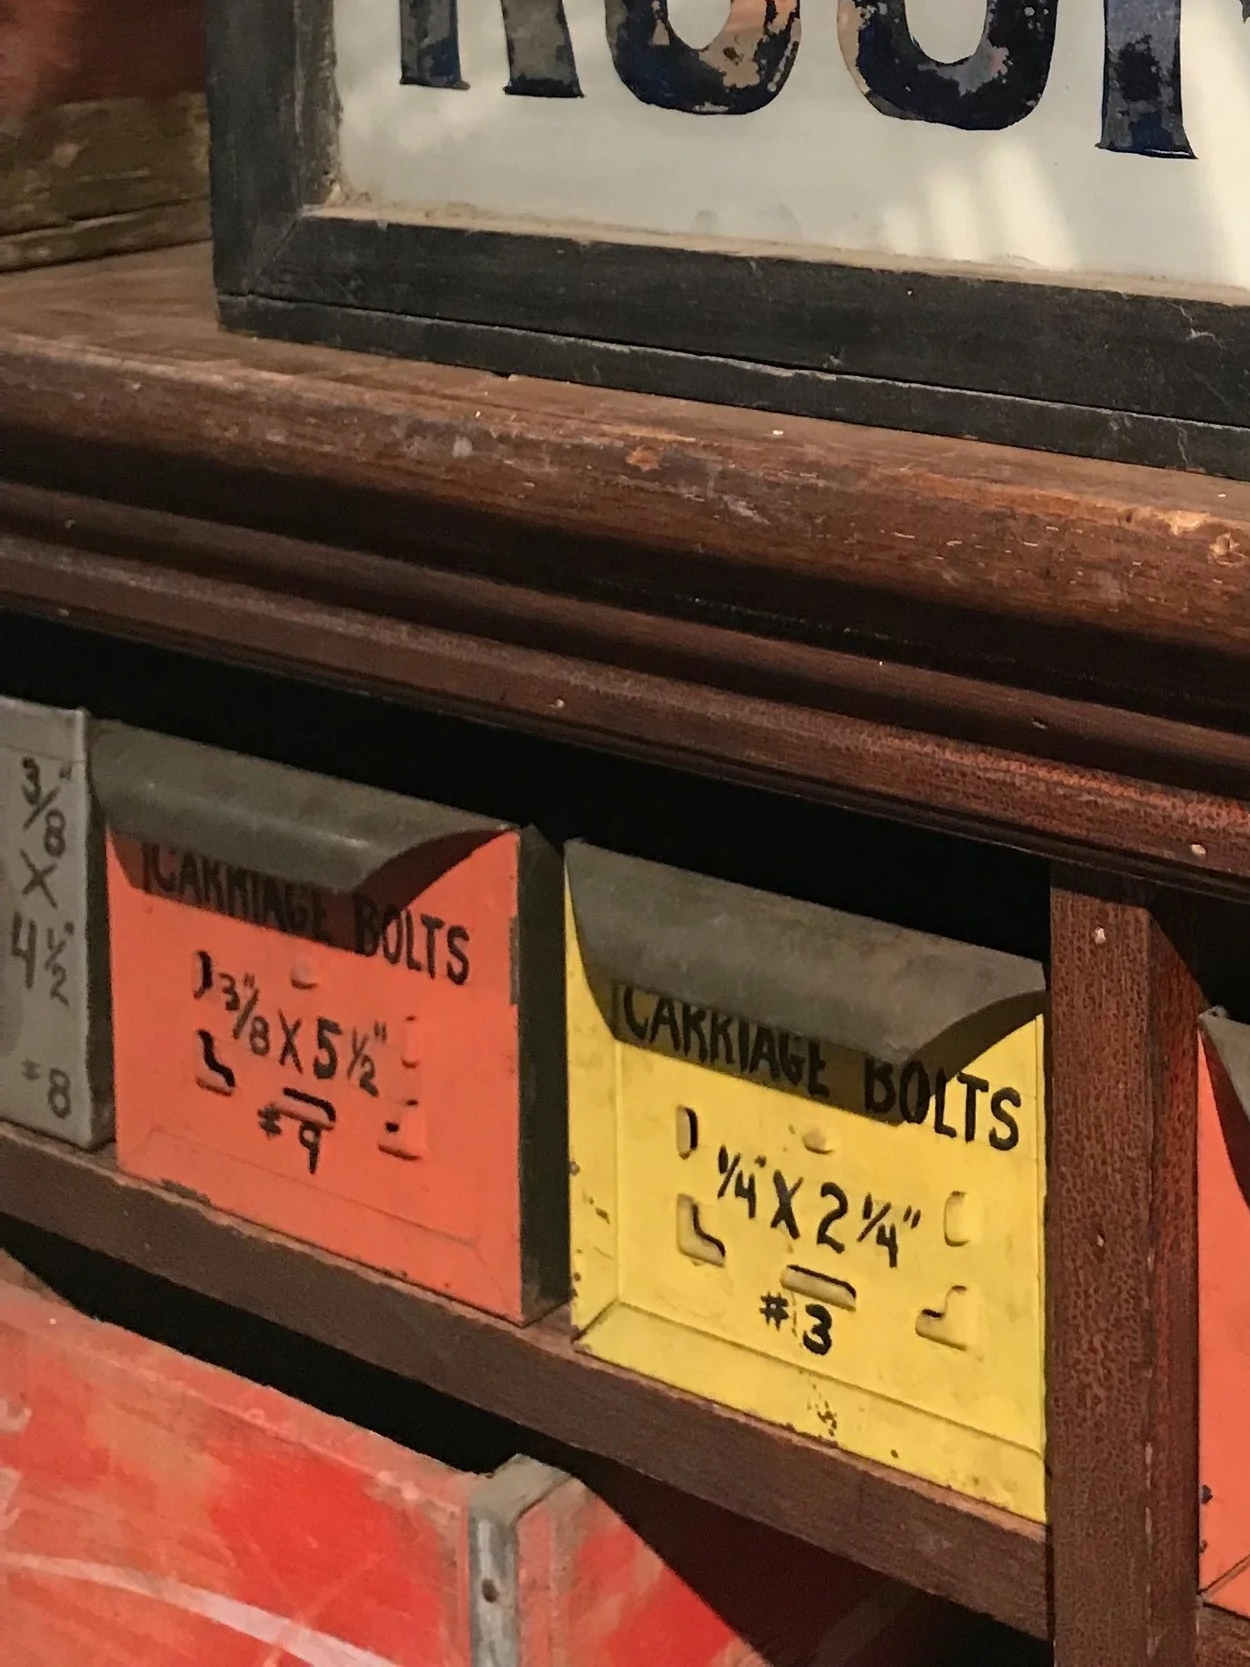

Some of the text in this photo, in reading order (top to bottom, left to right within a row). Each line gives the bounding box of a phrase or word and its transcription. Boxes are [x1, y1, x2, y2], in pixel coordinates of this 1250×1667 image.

[153, 844, 471, 985] CARRIAGE BOLTS
[622, 987, 1022, 1152] CARRIAGE BOLTS
